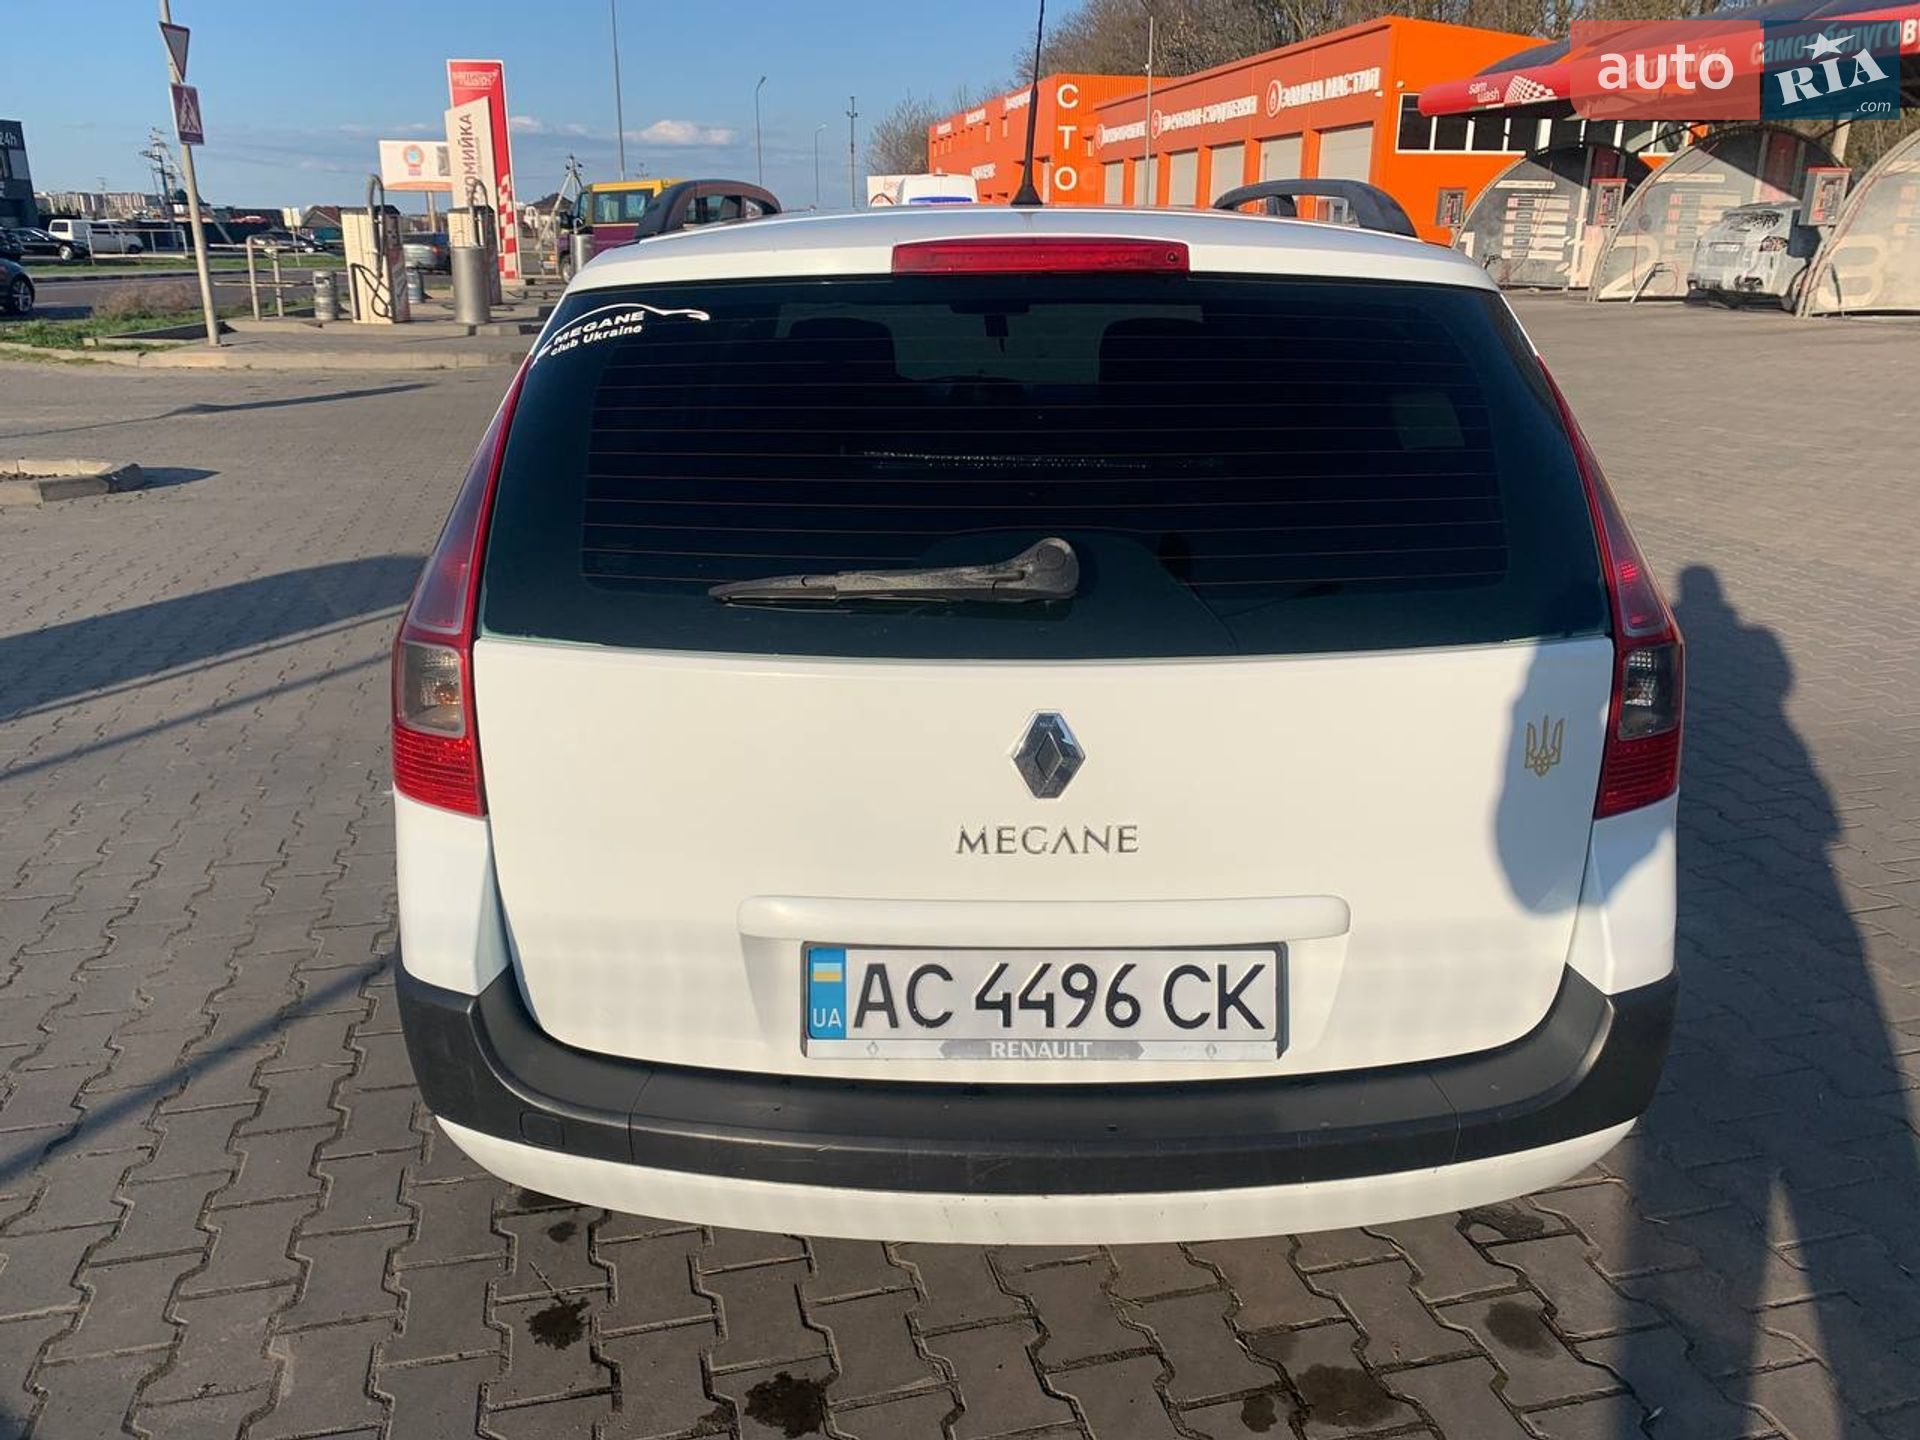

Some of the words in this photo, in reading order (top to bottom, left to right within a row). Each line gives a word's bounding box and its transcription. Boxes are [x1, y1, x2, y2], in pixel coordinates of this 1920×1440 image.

[550, 338, 579, 356] club
[583, 324, 643, 344] Ukraine
[553, 310, 645, 346] MEGANE
[955, 824, 1140, 855] MEGANE
[811, 1010, 842, 1028] UA
[853, 963, 954, 1029] AC
[974, 962, 1142, 1029] 4496
[1163, 963, 1266, 1031] CK
[990, 1040, 1093, 1059] RENAULT
